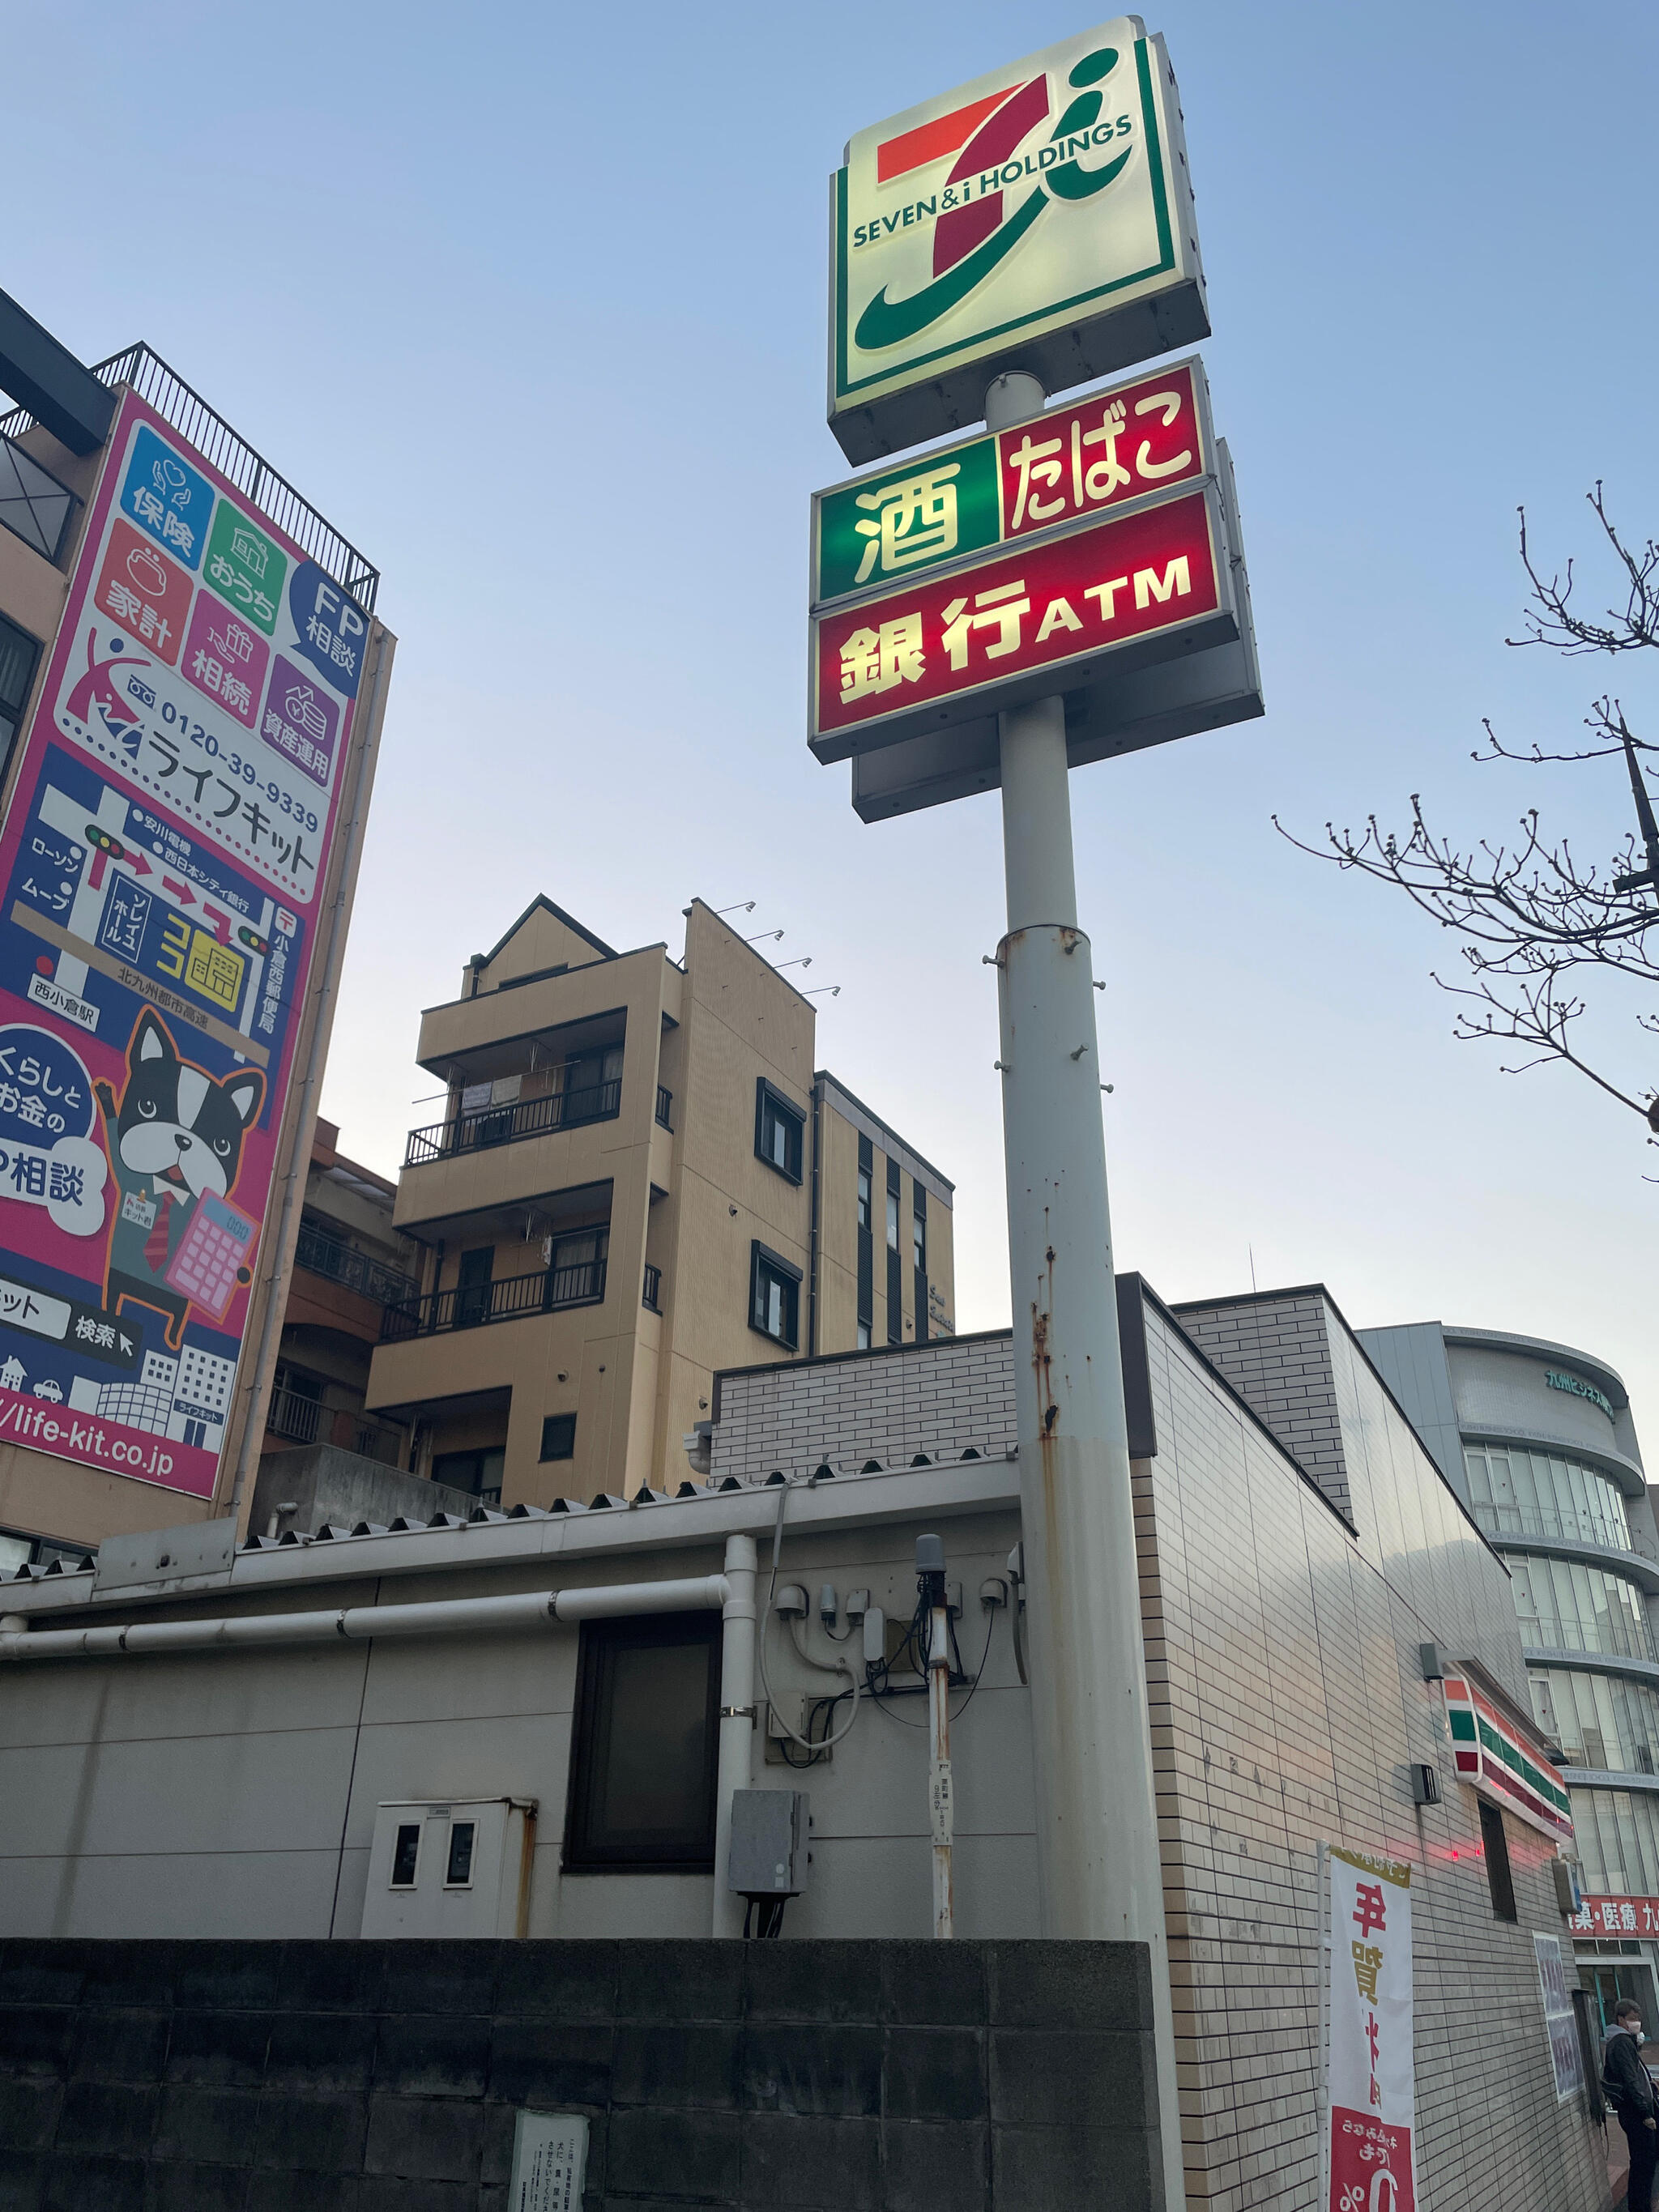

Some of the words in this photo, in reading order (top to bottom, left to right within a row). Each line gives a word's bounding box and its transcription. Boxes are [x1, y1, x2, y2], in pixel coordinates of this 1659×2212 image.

[980, 114, 1132, 194] HOLDINGS
[1009, 390, 1192, 531] たばこ
[133, 487, 195, 559] 保険
[854, 462, 961, 584] 酒
[105, 581, 173, 650] 家計
[210, 556, 275, 622] おうち
[315, 584, 365, 637] FP
[305, 620, 357, 678] 相談
[192, 648, 252, 716] 相続
[162, 702, 320, 833] 0120-39-9339
[262, 708, 331, 782] 資産運用
[143, 814, 192, 857] 安川電機
[148, 732, 314, 876] ライフキット
[32, 837, 79, 874] ローソン
[164, 850, 251, 914] 西日本シティ銀行
[21, 877, 70, 911] ムーブ
[106, 899, 128, 943] ホール
[123, 893, 147, 952] ソレイユ
[34, 981, 95, 1025] 西小倉駅
[117, 967, 209, 1029] 北九州都市高速
[258, 935, 290, 1035] 小倉西郵便局
[0, 1046, 82, 1109] くらしと
[0, 1289, 40, 1319] ット
[75, 1315, 116, 1349] 検索
[0, 1399, 173, 1477] /life-kit.co.jp
